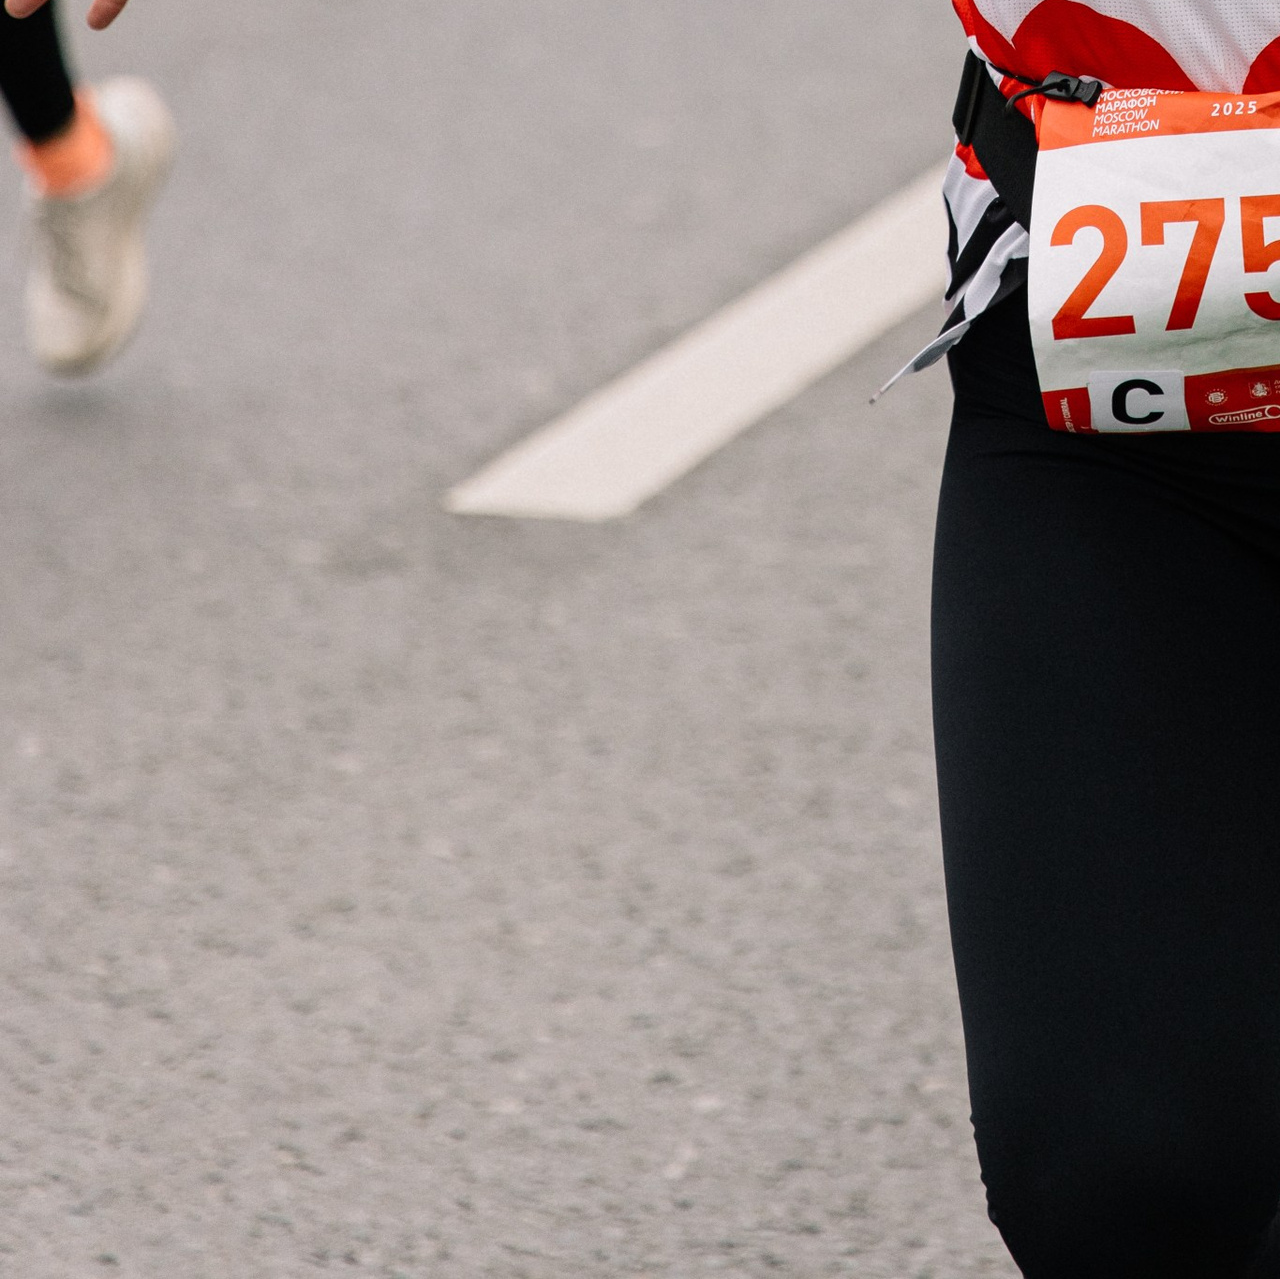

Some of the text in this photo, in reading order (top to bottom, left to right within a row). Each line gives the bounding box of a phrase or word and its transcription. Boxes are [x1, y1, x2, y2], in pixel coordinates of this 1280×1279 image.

[1095, 96, 1157, 114] МАРАФОН
[1211, 101, 1257, 117] 2025
[1093, 108, 1148, 125] MOSCOW
[1092, 119, 1160, 137] MARATHON
[1111, 378, 1165, 425] C
[1215, 411, 1263, 423] Winline
